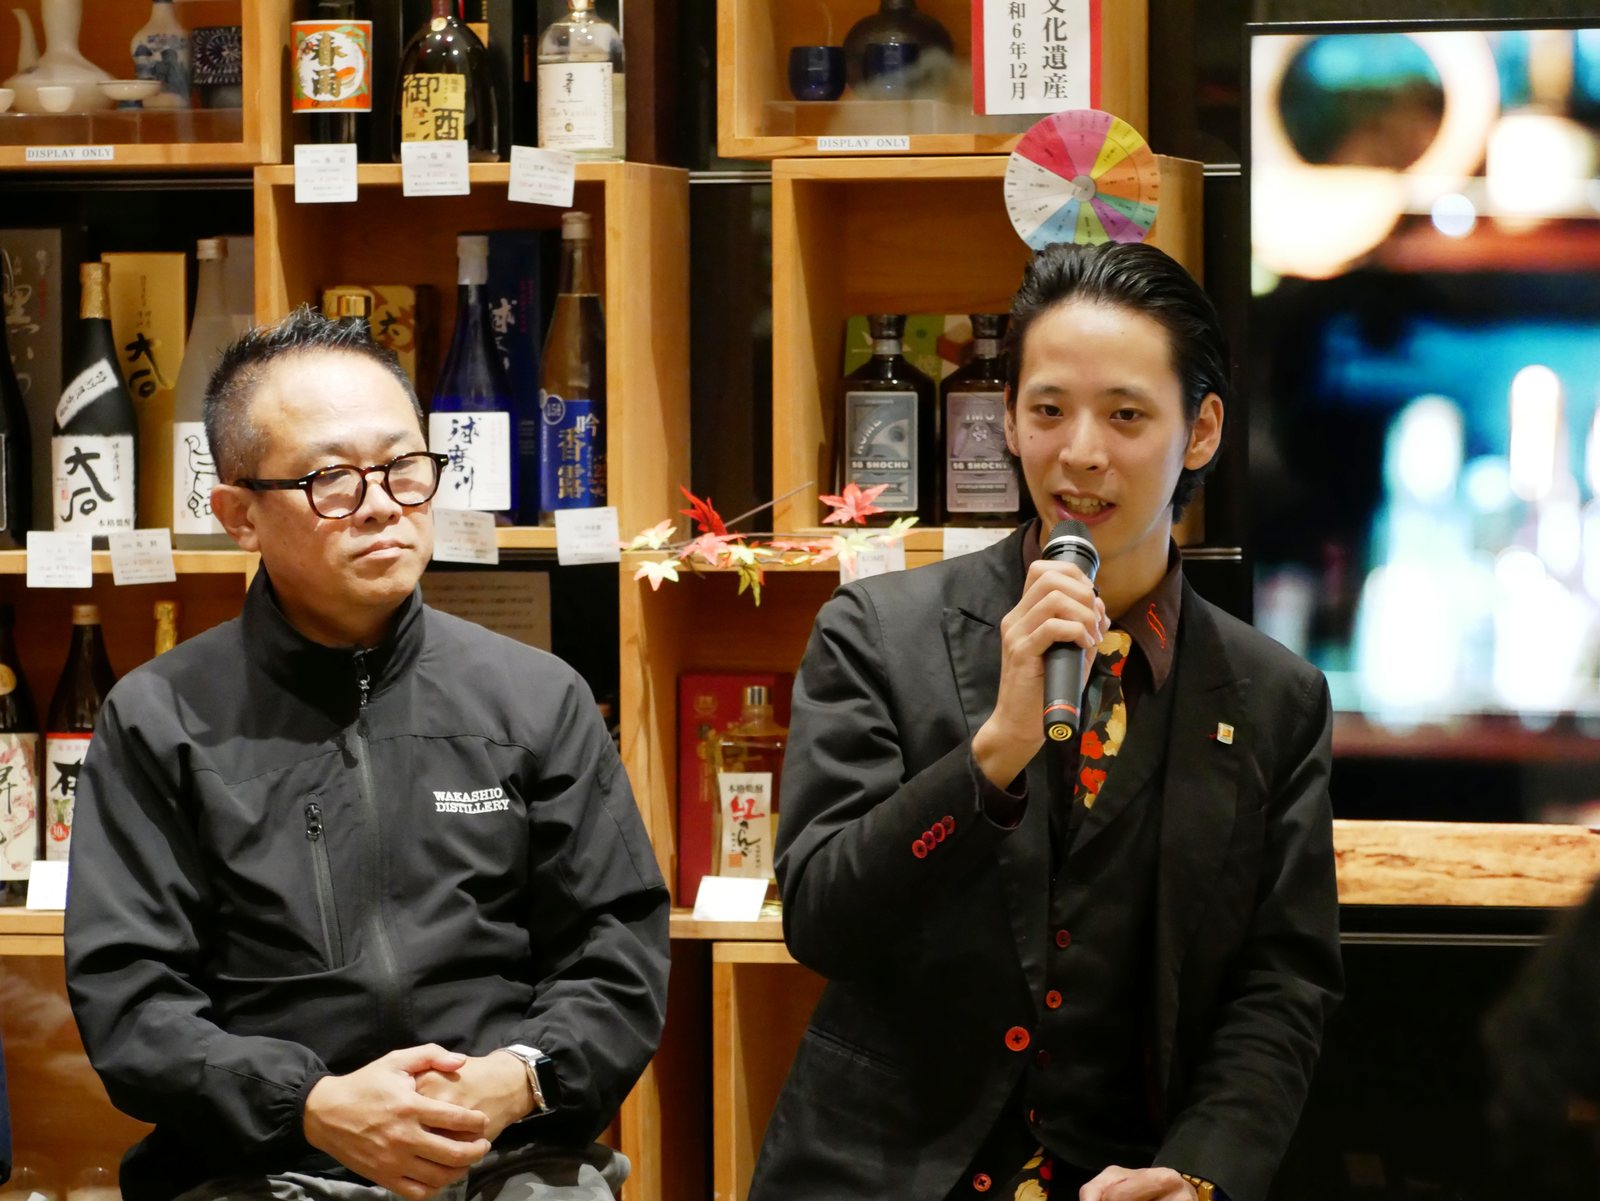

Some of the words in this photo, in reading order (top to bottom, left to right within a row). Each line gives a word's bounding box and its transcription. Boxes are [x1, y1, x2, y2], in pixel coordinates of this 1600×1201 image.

[1009, 1, 1028, 100] 和6年12月
[820, 139, 870, 148] DISPLAY
[877, 138, 907, 147] ONLY
[27, 149, 75, 159] DISPLAY
[82, 148, 112, 158] ONLY
[866, 461, 909, 469] SHOCHU
[60, 446, 115, 523] 大石
[433, 787, 503, 802] WAKASHIO
[435, 799, 510, 815] DISTILLERY
